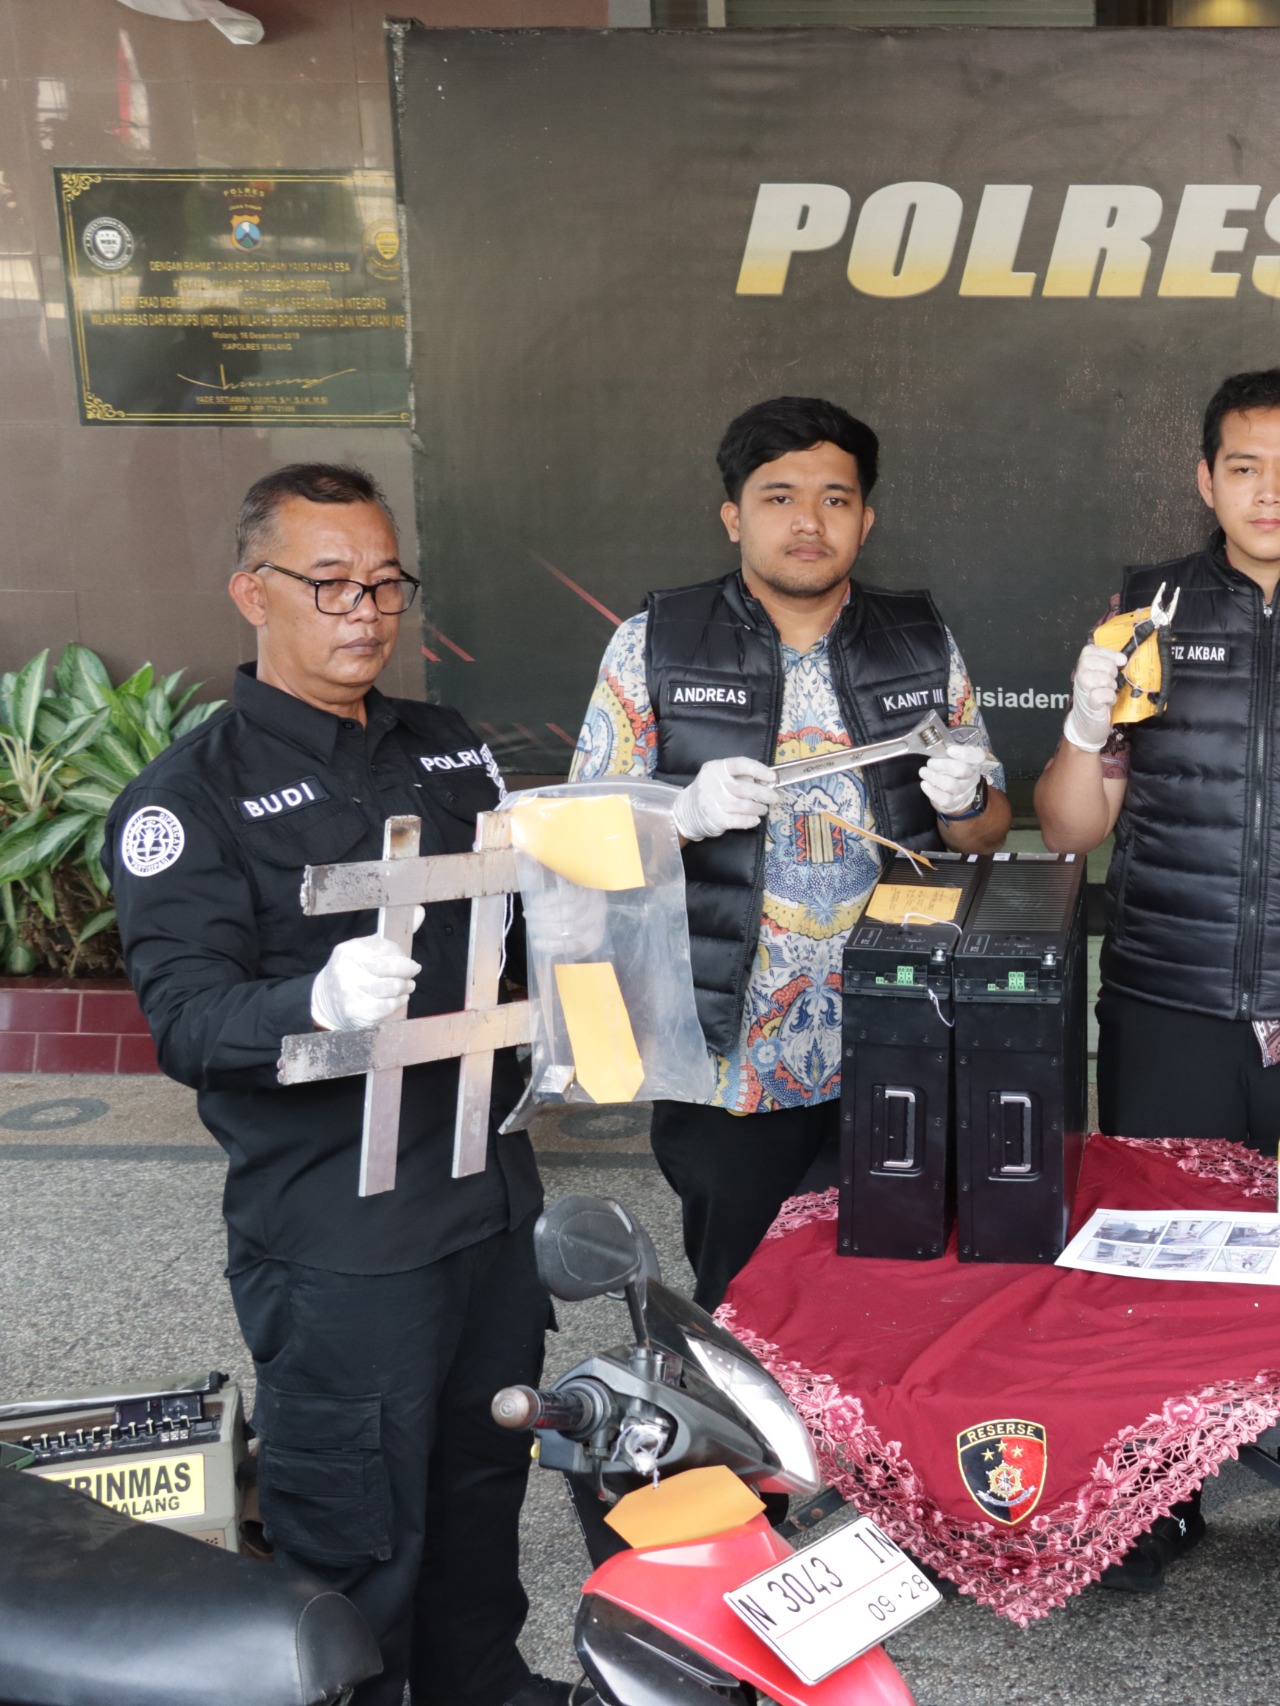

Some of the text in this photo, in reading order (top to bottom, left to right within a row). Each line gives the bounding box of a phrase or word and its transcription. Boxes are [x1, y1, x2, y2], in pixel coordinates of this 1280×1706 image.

[223, 187, 265, 197] POLRES
[1187, 645, 1226, 662] AKBAR
[673, 687, 747, 705] ANDREAS
[882, 688, 945, 711] KANIT III
[419, 749, 483, 772] POLRI
[242, 781, 316, 819] BUDI
[966, 1423, 1036, 1443] RESERSE
[737, 1594, 778, 1631] N
[767, 1556, 844, 1613] 3043
